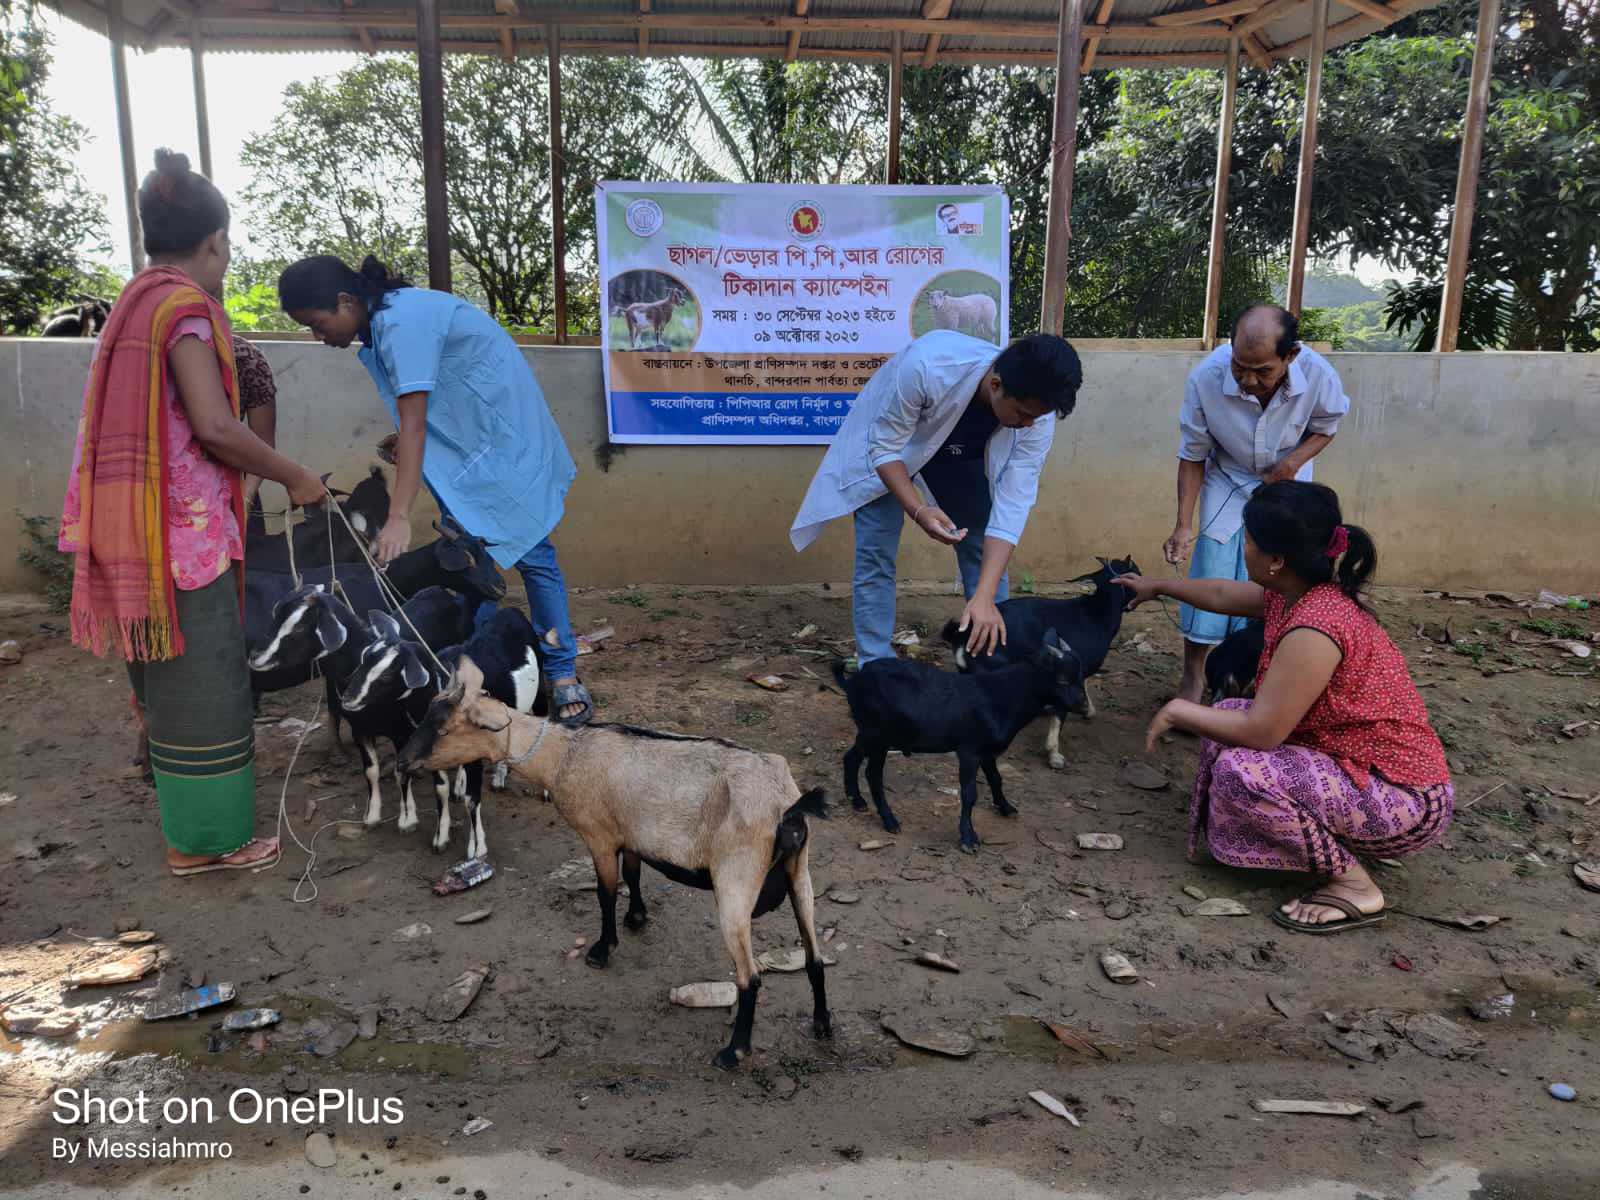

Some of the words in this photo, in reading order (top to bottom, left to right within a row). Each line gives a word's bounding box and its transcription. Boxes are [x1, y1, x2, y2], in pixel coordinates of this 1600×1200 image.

[885, 246, 945, 266] রোগের
[722, 272, 796, 297] টিকাদান
[800, 272, 890, 297] ক্যাম্পেইন
[712, 309, 738, 323] সময়
[754, 312, 773, 322] ৩০
[777, 307, 822, 322] সেপ্টেম্বর
[826, 311, 860, 323] ২০২৩
[864, 307, 897, 322] হইতে
[754, 332, 772, 343] ০৯
[776, 328, 820, 343] অক্টোবর
[825, 331, 860, 344] ২০২৩
[704, 357, 751, 369] উপজেলা
[765, 376, 812, 387] বান্দরবান
[726, 396, 771, 409] পিপিআর
[775, 399, 798, 409] রোগ
